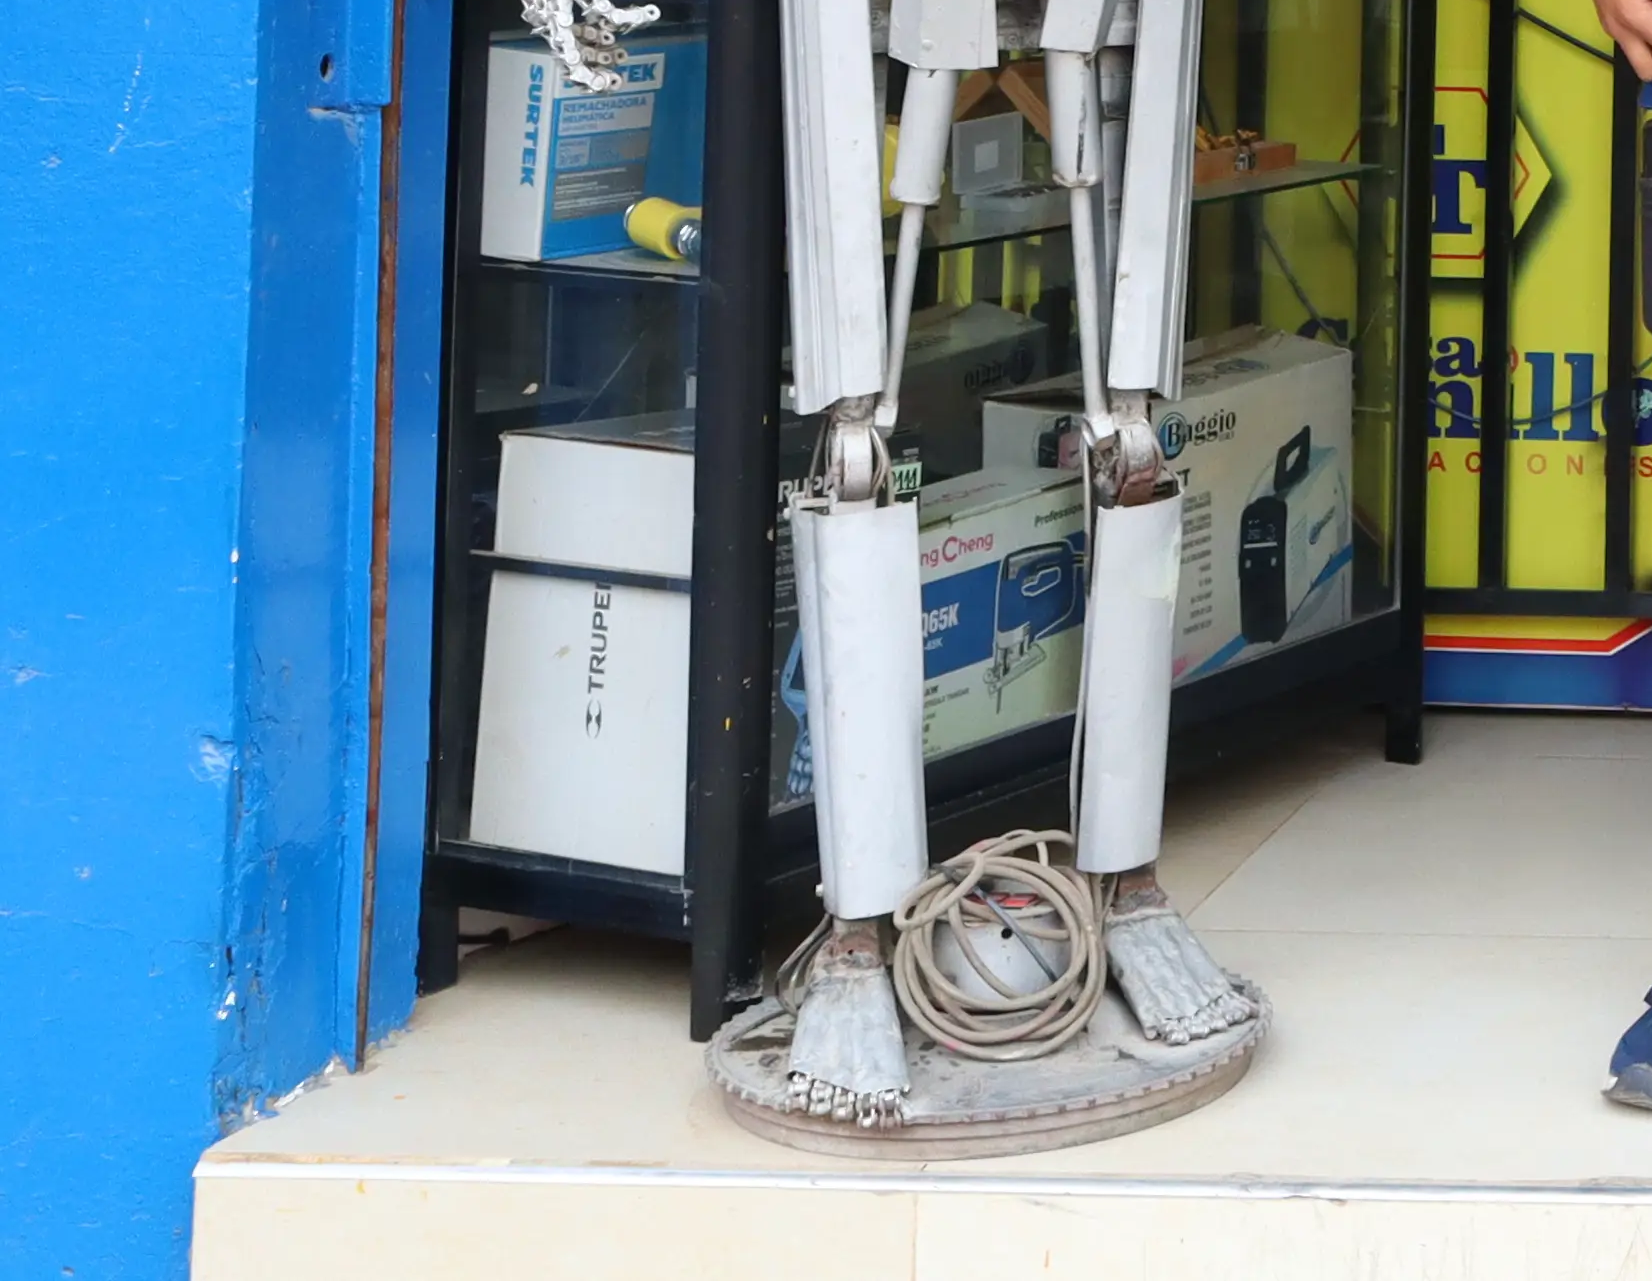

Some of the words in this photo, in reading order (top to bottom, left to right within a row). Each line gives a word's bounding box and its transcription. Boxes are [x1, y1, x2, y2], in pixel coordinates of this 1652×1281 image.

[563, 96, 648, 114] REMACHADORA
[519, 63, 544, 188] SURTEK
[1166, 408, 1236, 448] Baggio
[942, 534, 994, 563] Cheng
